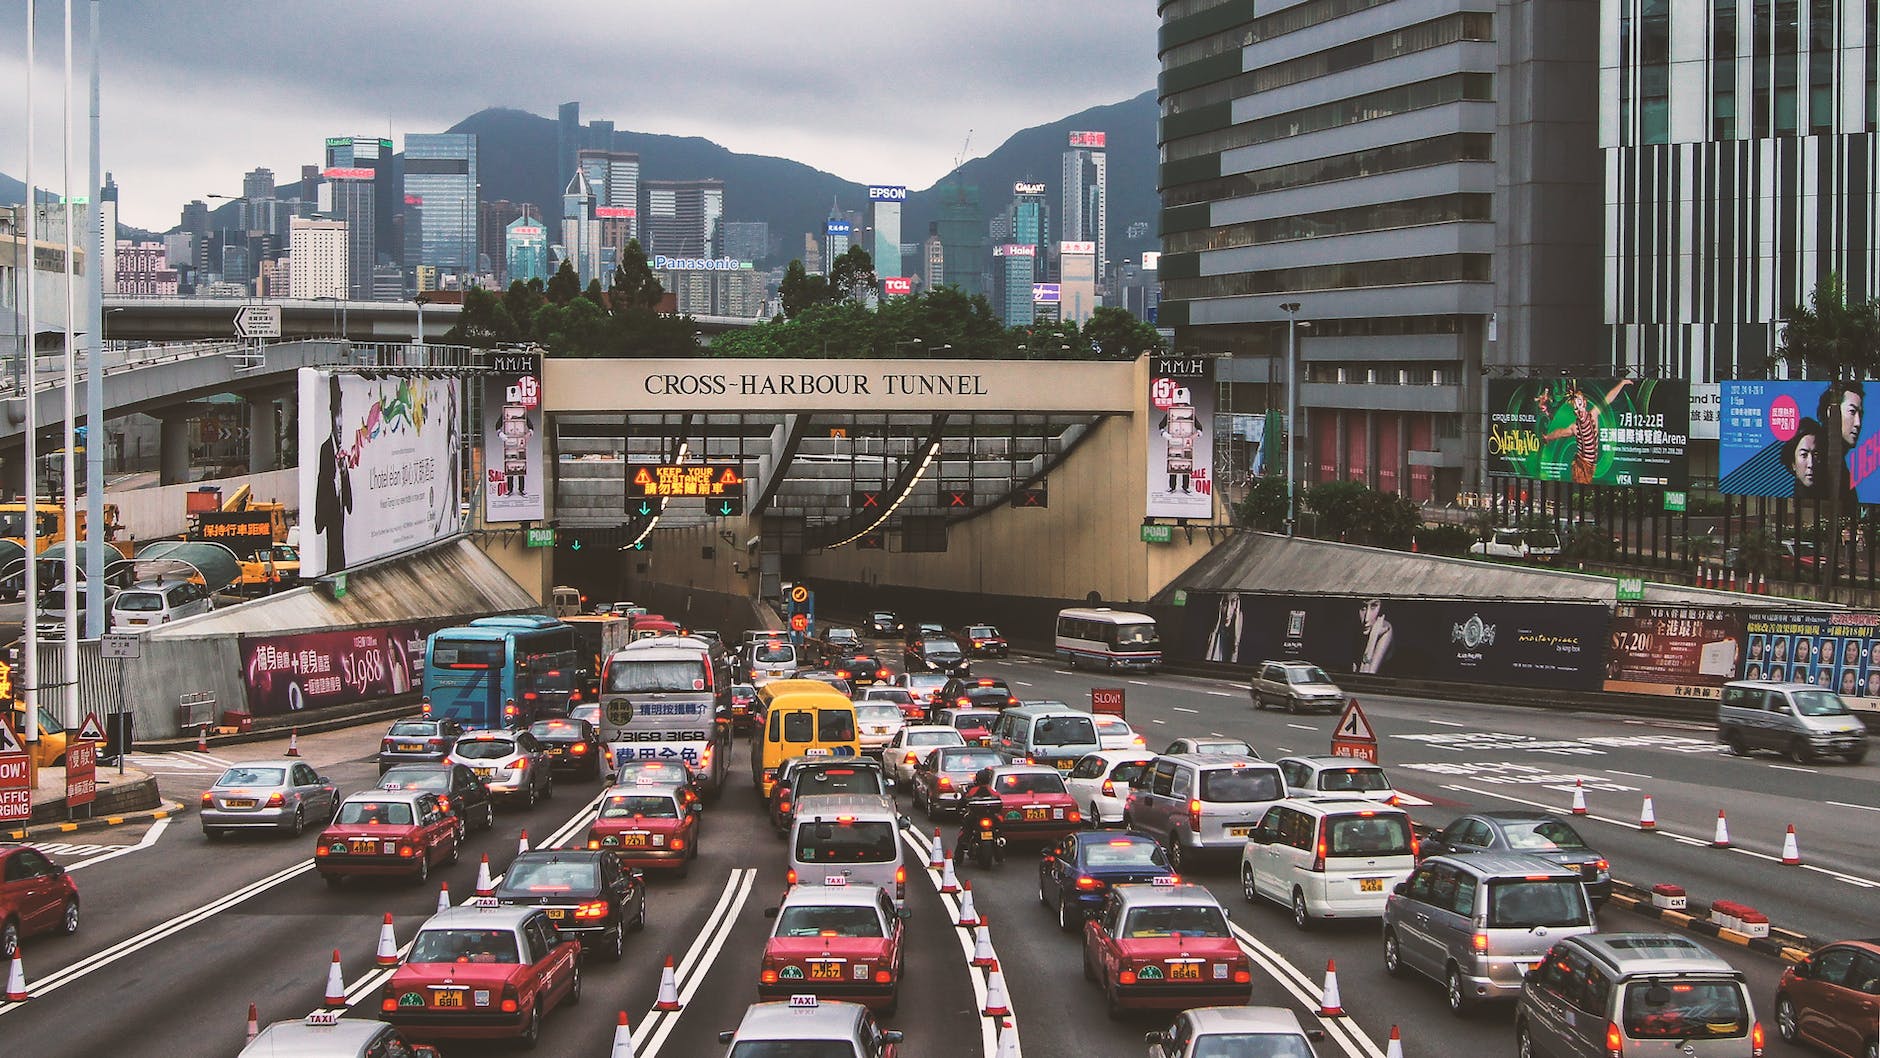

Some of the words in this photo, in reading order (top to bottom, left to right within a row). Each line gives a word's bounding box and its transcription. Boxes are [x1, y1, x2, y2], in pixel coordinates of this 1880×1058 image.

[1015, 183, 1045, 191] GALAXY
[869, 188, 906, 199] EPSON
[1009, 246, 1034, 256] Haier
[655, 255, 740, 270] Panasonic
[886, 281, 910, 290] TCL
[883, 375, 988, 396] TUNNEL
[1492, 414, 1509, 424] CIRQUE
[1511, 414, 1519, 422] DU
[1519, 414, 1537, 423] SOLEIL
[1620, 411, 1665, 428] 7月12-22日
[488, 469, 505, 482] SALE
[656, 467, 682, 475] KEEP
[688, 467, 713, 476] YOUR
[1190, 468, 1205, 480] SALE
[660, 475, 710, 483] DISTANCE
[1616, 474, 1632, 485] VISA
[645, 482, 724, 494] 請勿緊隨前車
[1196, 480, 1211, 496] ON
[1666, 492, 1684, 505] POAD
[203, 523, 270, 537] 保持行車距離
[530, 530, 551, 541] POAD
[1143, 526, 1168, 537] POAD
[1619, 578, 1641, 593] POAD
[1656, 619, 1704, 638] 全港最貴
[1518, 634, 1579, 646] masterpiece
[1611, 632, 1654, 651] $7,200
[344, 650, 382, 694] $1,988
[1094, 692, 1121, 704] SLOW!
[622, 731, 661, 741] 3168
[667, 731, 705, 741] 3168
[792, 997, 814, 1005] TAXI
[309, 1015, 332, 1023] TAXI
